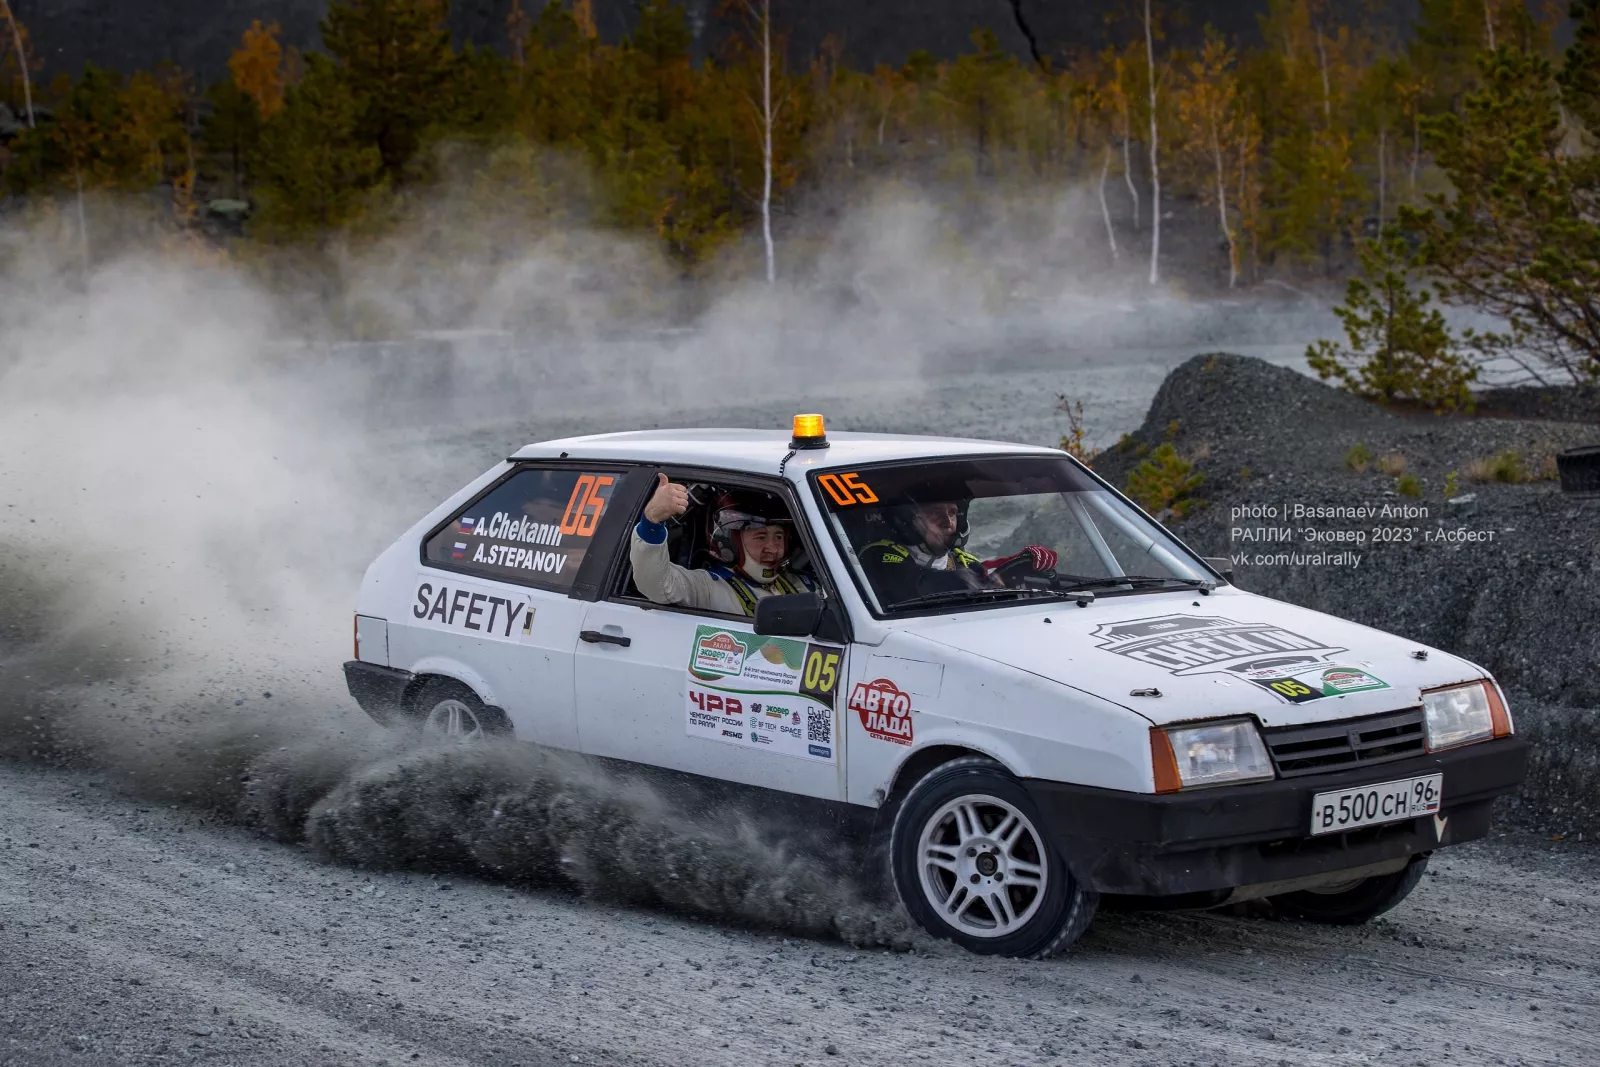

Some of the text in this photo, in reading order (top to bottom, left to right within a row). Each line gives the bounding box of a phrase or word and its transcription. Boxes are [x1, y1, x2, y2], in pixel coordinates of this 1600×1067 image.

[818, 472, 880, 506] 05
[560, 475, 615, 537] 05
[473, 543, 567, 574] A.STEPANOV
[413, 583, 525, 637] SAFETY
[804, 650, 839, 693] 05
[1270, 680, 1311, 697] 05
[689, 690, 743, 716] ЧРР
[850, 686, 909, 718] АВТО
[689, 711, 744, 728] ЧЕМПИОНАТ РОССИИ
[765, 722, 777, 731] TECH
[780, 725, 802, 736] SPACE
[866, 711, 912, 738] ЛАДА
[1414, 779, 1434, 804] 96
[1411, 802, 1426, 812] RUS
